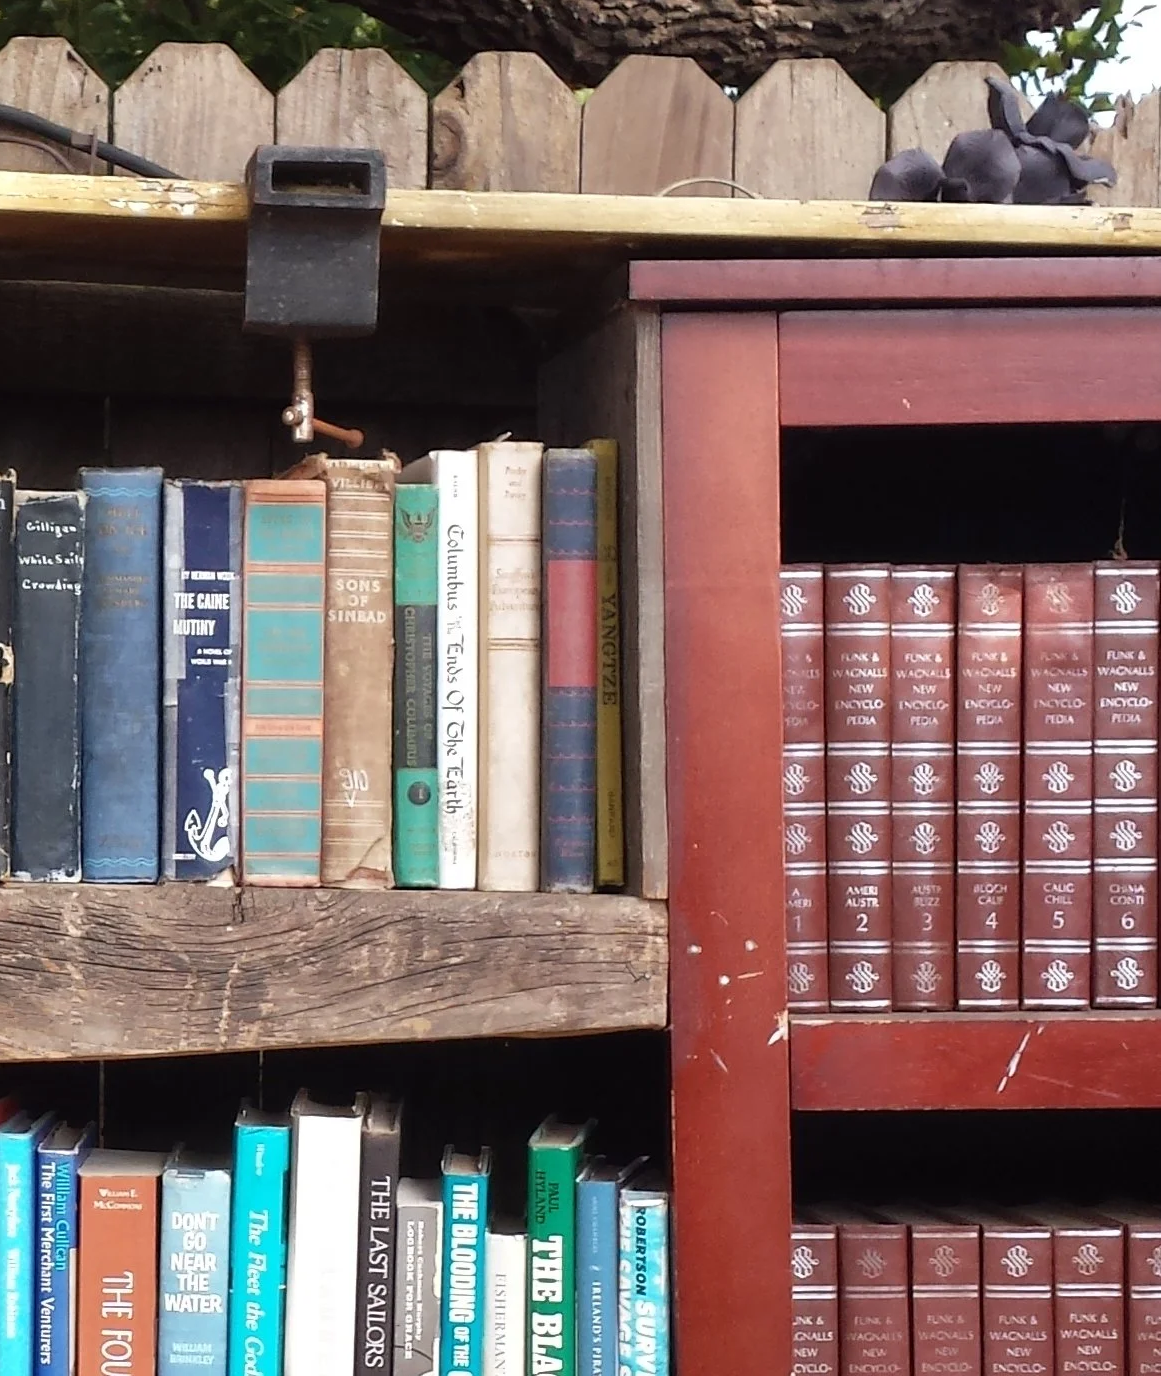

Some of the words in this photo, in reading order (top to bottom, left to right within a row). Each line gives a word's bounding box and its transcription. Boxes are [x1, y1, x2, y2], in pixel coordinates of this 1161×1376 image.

[336, 579, 381, 592] SONS
[173, 593, 195, 611] THE
[198, 592, 231, 611] CAINE
[348, 595, 368, 607] OF
[328, 610, 386, 623] SINBAD
[173, 620, 215, 637] MUTINY
[599, 592, 618, 706] YANGTZE
[1107, 650, 1135, 661] FUNK
[1138, 651, 1146, 660] &
[1098, 665, 1155, 676] WAGNALLS
[1114, 682, 1138, 692] NEW
[1111, 713, 1140, 724] PEDIA
[846, 885, 878, 896] AMERI
[1045, 894, 1073, 905] CHILL
[855, 914, 868, 932] 2
[1053, 911, 1064, 928] 5
[1122, 913, 1134, 929] 6
[42, 1162, 56, 1188] The
[41, 1190, 56, 1223] First
[371, 1175, 390, 1219] THE
[453, 1183, 478, 1221] THE
[249, 1210, 269, 1247] The
[183, 1232, 206, 1251] GO
[369, 1223, 390, 1279] LAST
[636, 1206, 646, 1295] ROBERTSON
[40, 1226, 53, 1295] Merchant
[171, 1253, 216, 1272] NEAR
[533, 1236, 563, 1302] THE
[177, 1273, 209, 1292] THE
[247, 1253, 267, 1295] Fleet
[448, 1225, 477, 1325] BLOODING
[101, 1271, 134, 1319] THE
[164, 1293, 223, 1313] WATER
[246, 1299, 265, 1332] the
[38, 1297, 53, 1366] Venturers
[365, 1285, 386, 1369] SAILORS
[455, 1327, 472, 1341] OF
[454, 1342, 472, 1368] THE
